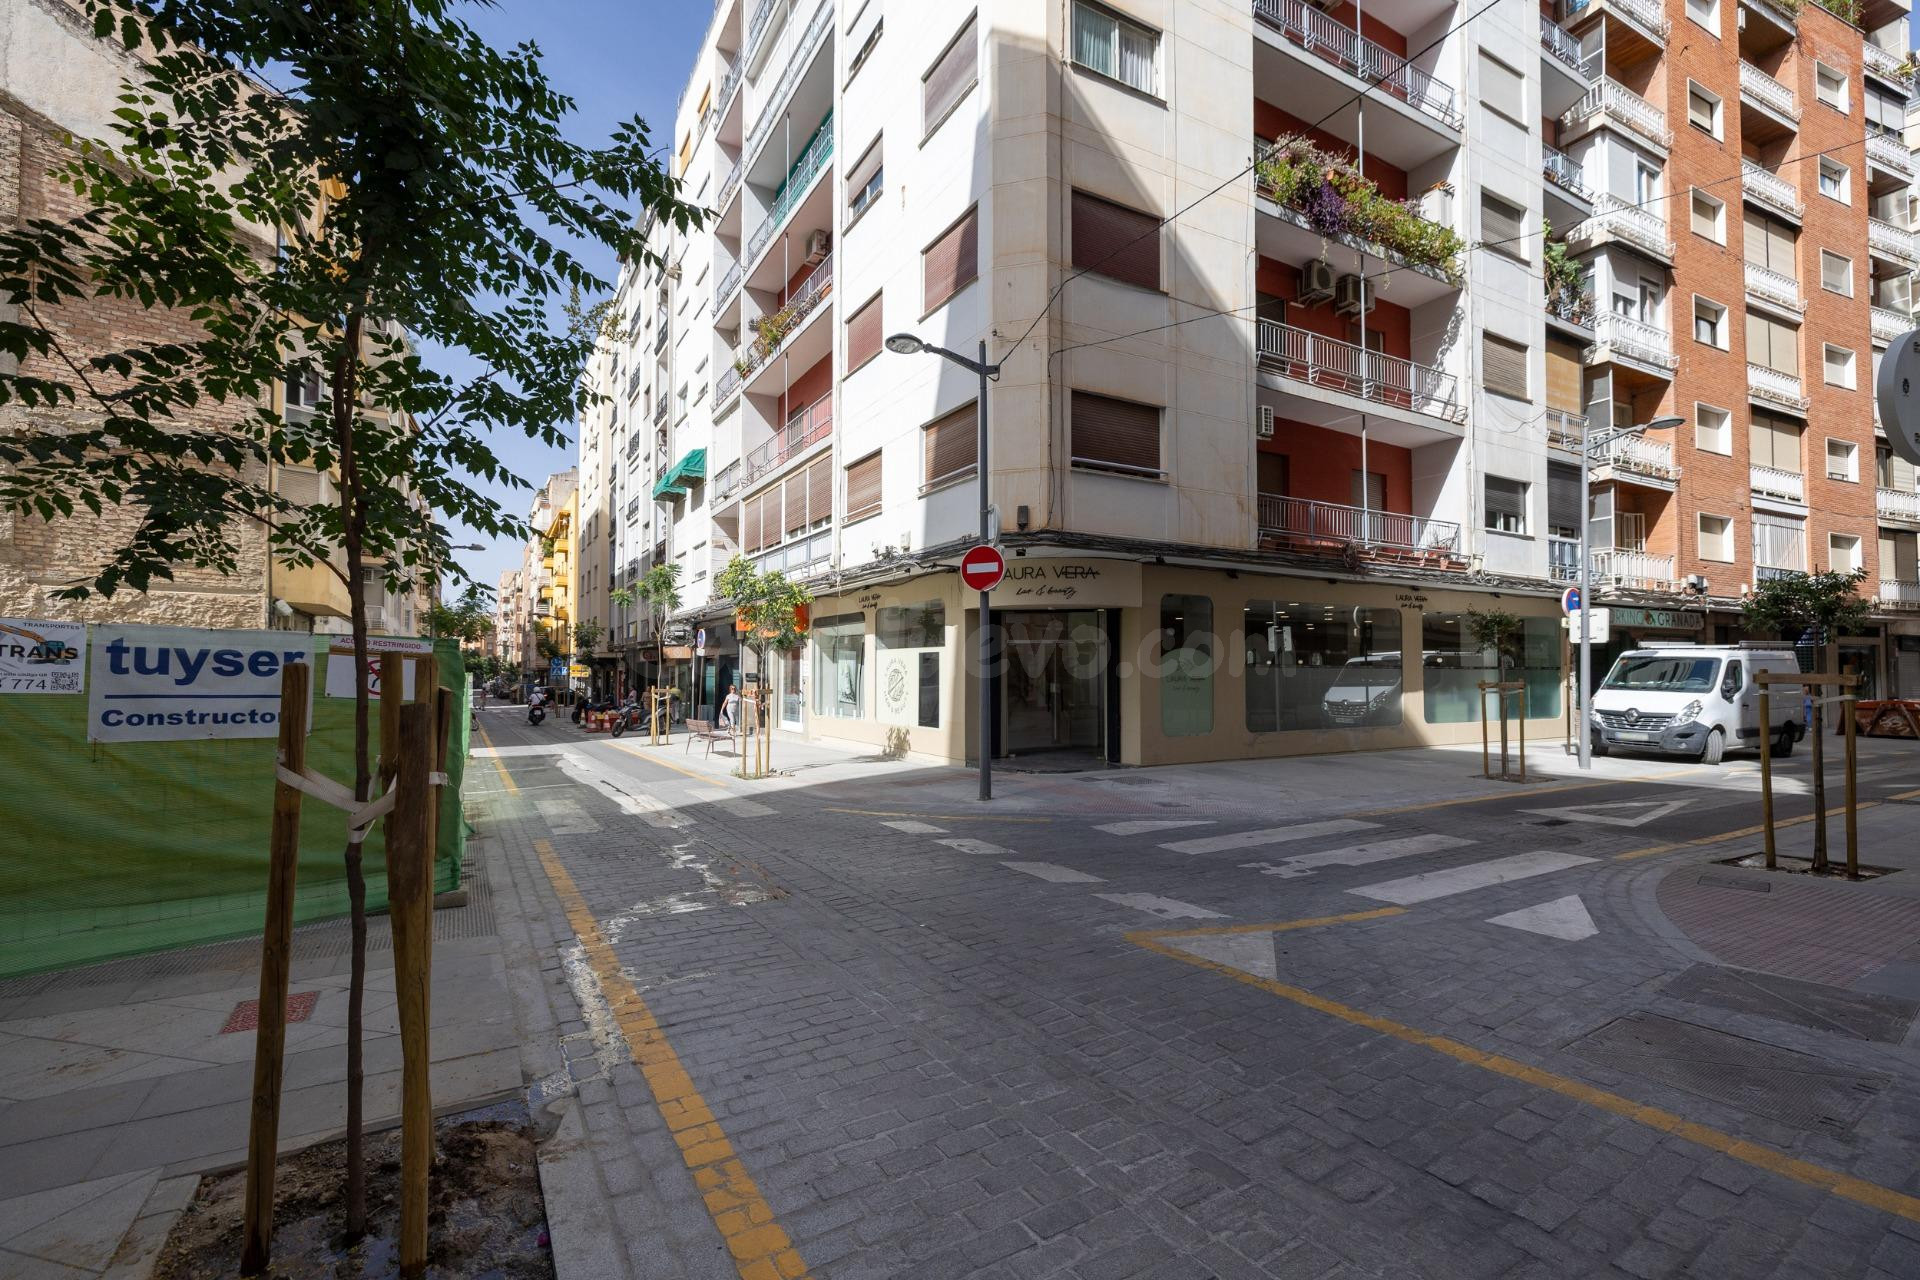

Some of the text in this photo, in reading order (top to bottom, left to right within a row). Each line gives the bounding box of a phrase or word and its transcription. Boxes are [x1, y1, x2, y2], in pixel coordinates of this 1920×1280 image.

[1003, 565, 1100, 580] AURA VERA
[23, 622, 80, 630] TRANSPORTES
[106, 637, 305, 685] tuyser
[11, 678, 47, 690] 774
[101, 709, 281, 726] Constructo
